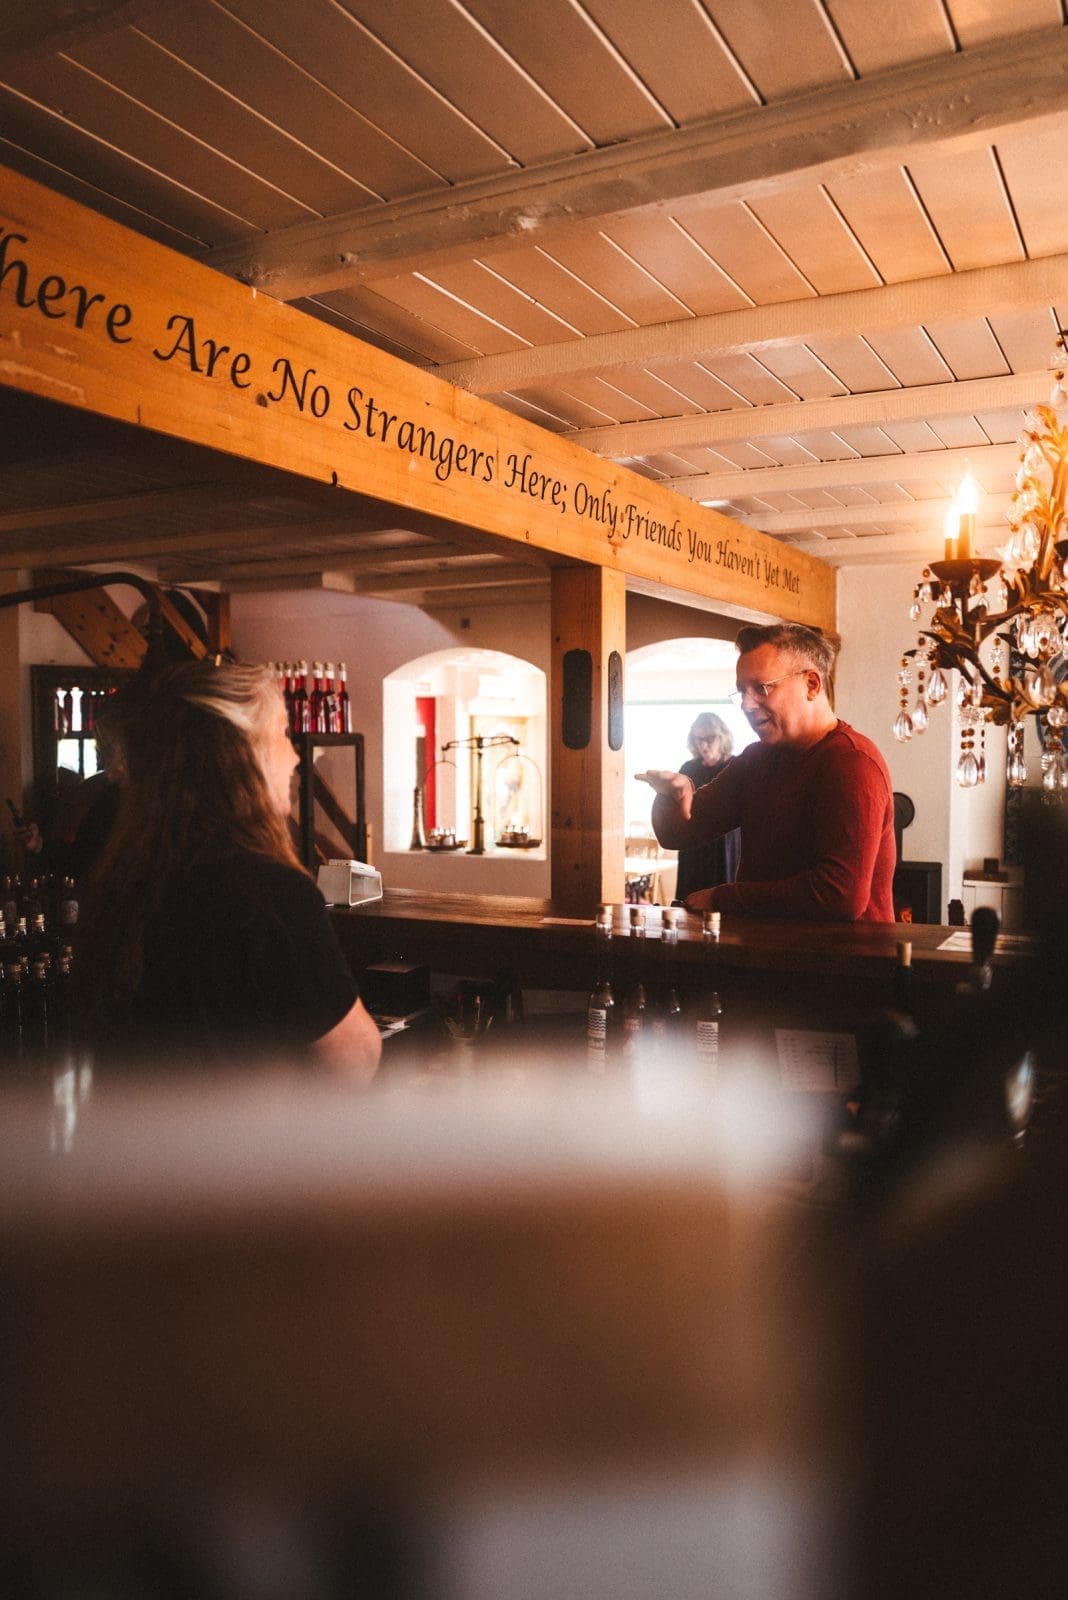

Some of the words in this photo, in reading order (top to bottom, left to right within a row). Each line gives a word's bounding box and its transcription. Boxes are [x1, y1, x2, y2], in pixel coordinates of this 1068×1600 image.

[0, 227, 133, 343] here
[153, 315, 251, 389] Are
[267, 358, 330, 418] No
[343, 387, 495, 481] Strangers
[504, 454, 567, 513] Here;
[574, 482, 618, 539] Only
[622, 504, 682, 552] Friends
[687, 529, 711, 562] You
[716, 541, 760, 580] Haven't
[764, 558, 779, 588] Yet
[782, 568, 800, 594] Met
